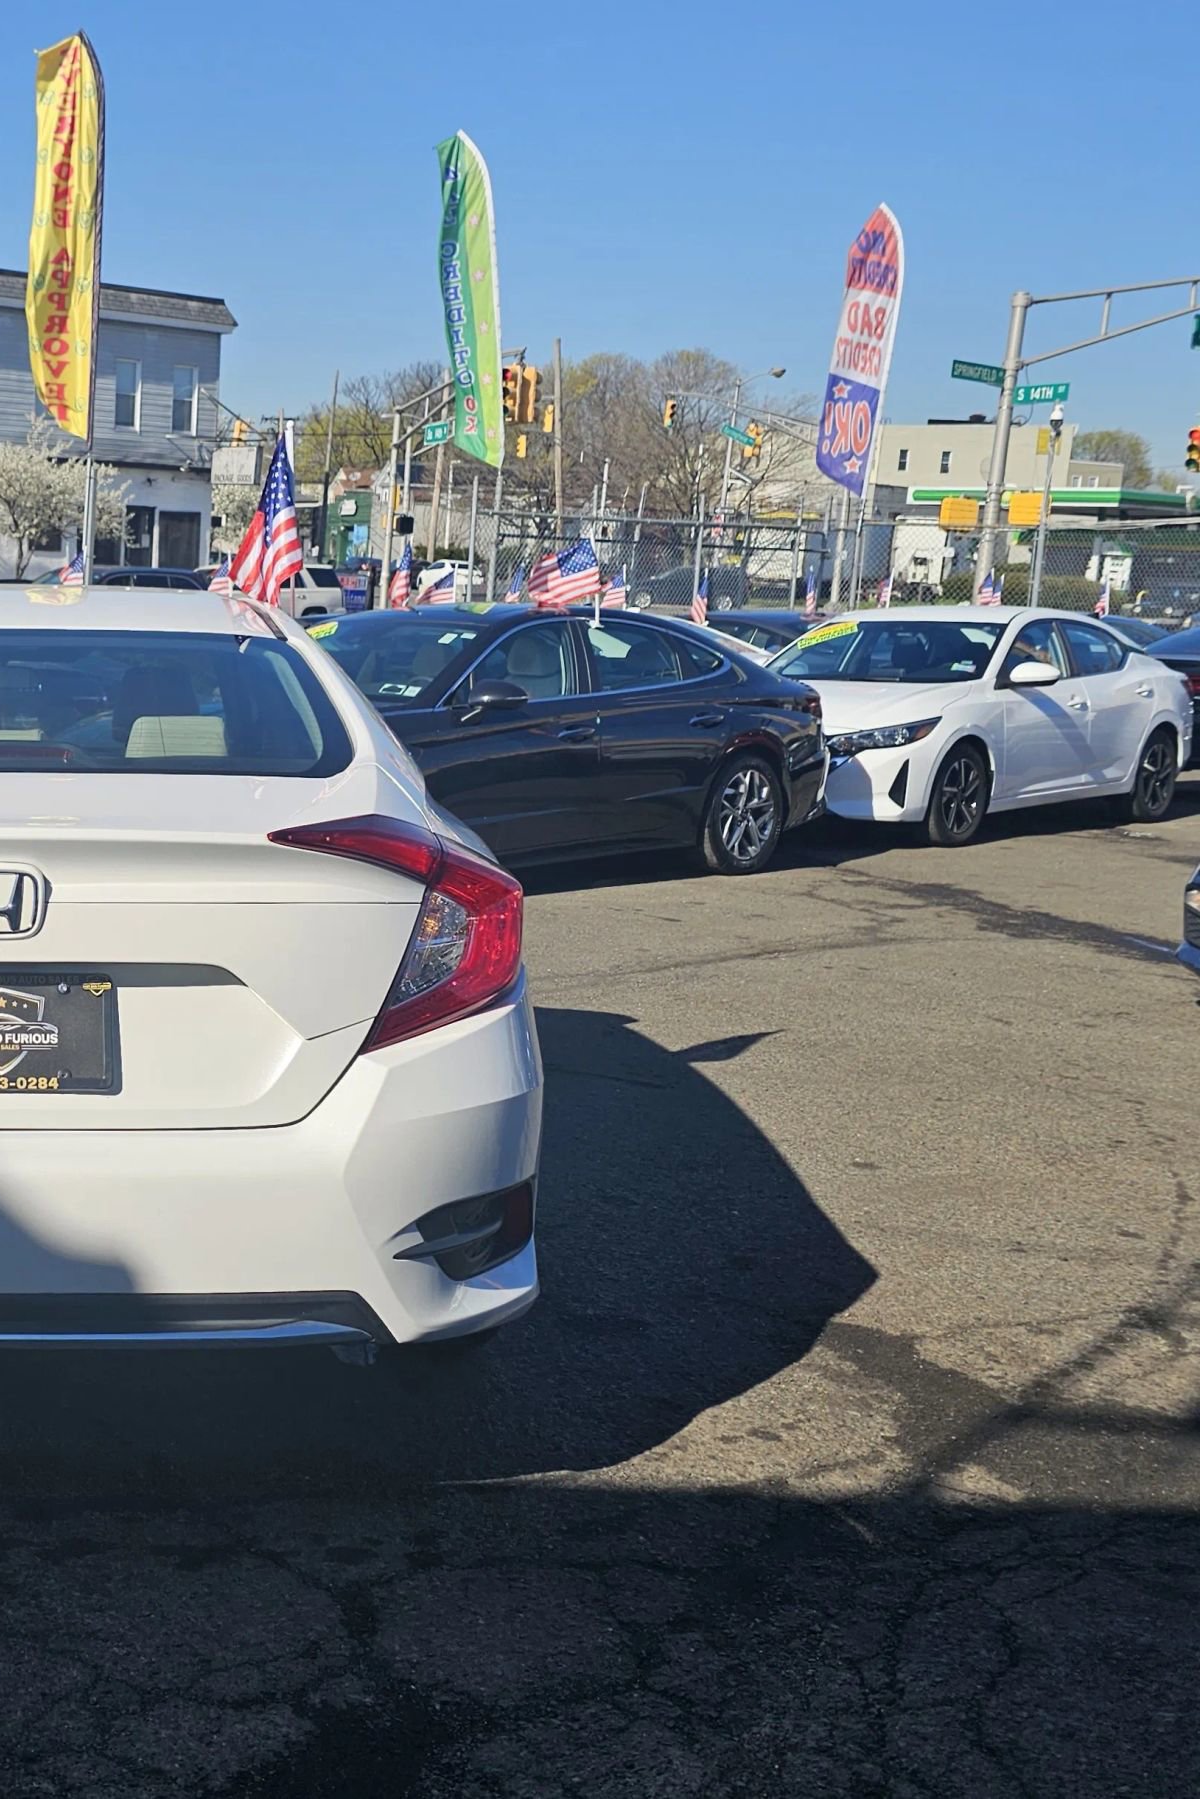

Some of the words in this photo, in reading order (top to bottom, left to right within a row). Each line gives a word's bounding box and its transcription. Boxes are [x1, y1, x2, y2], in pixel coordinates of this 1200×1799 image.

[953, 362, 998, 382] SPRINGFIELD
[1017, 388, 1025, 401] S
[1029, 387, 1054, 401] 14TH
[18, 976, 46, 985] AUTO
[49, 976, 80, 985] SALES
[5, 1033, 59, 1044] FURIOUS
